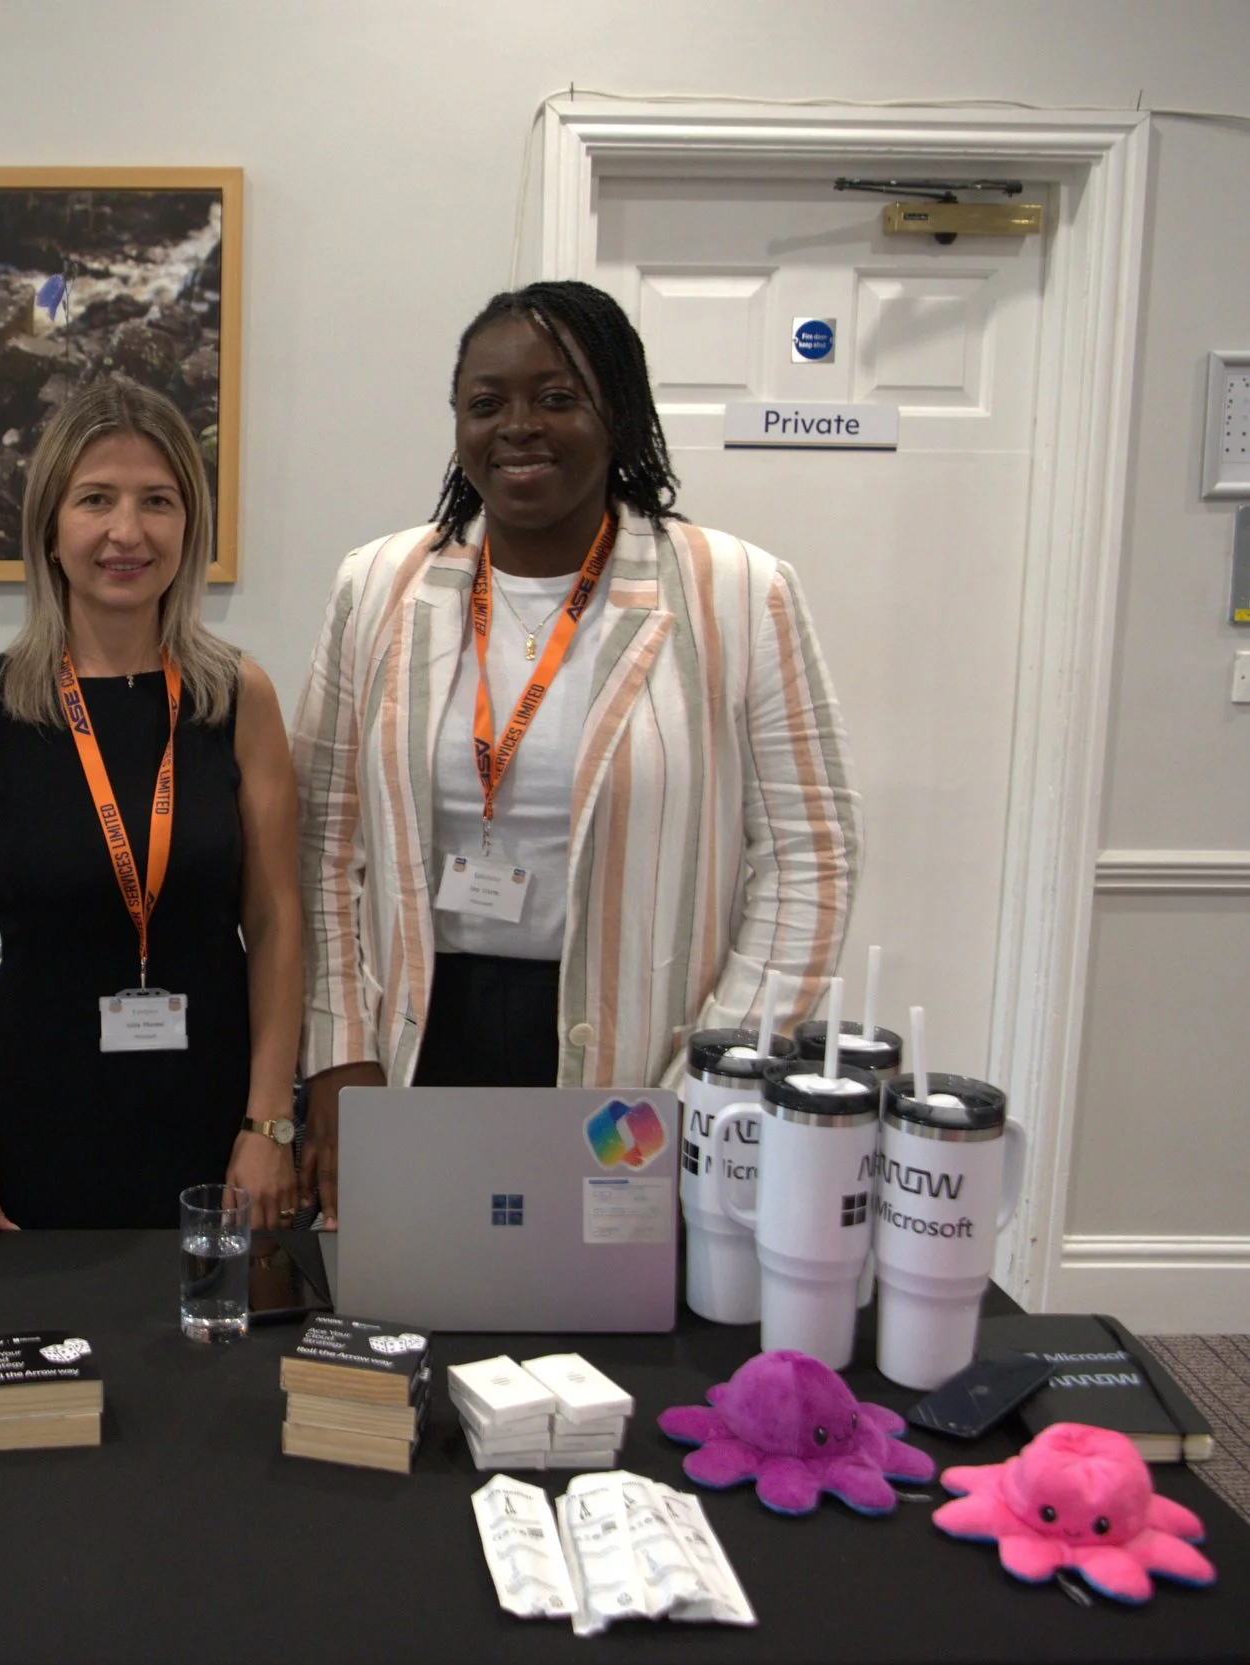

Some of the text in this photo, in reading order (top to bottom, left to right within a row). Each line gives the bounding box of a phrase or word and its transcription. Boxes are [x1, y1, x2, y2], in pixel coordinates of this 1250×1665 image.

[764, 410, 860, 435] Private
[567, 575, 595, 623] ASE
[63, 689, 91, 735] ASE
[514, 683, 545, 726] LIMITED
[155, 769, 170, 815] LIMITED
[100, 803, 127, 849] LIMITED
[115, 851, 139, 907] SERVICES
[875, 1196, 973, 1238] Microsoft
[58, 1368, 80, 1376] way
